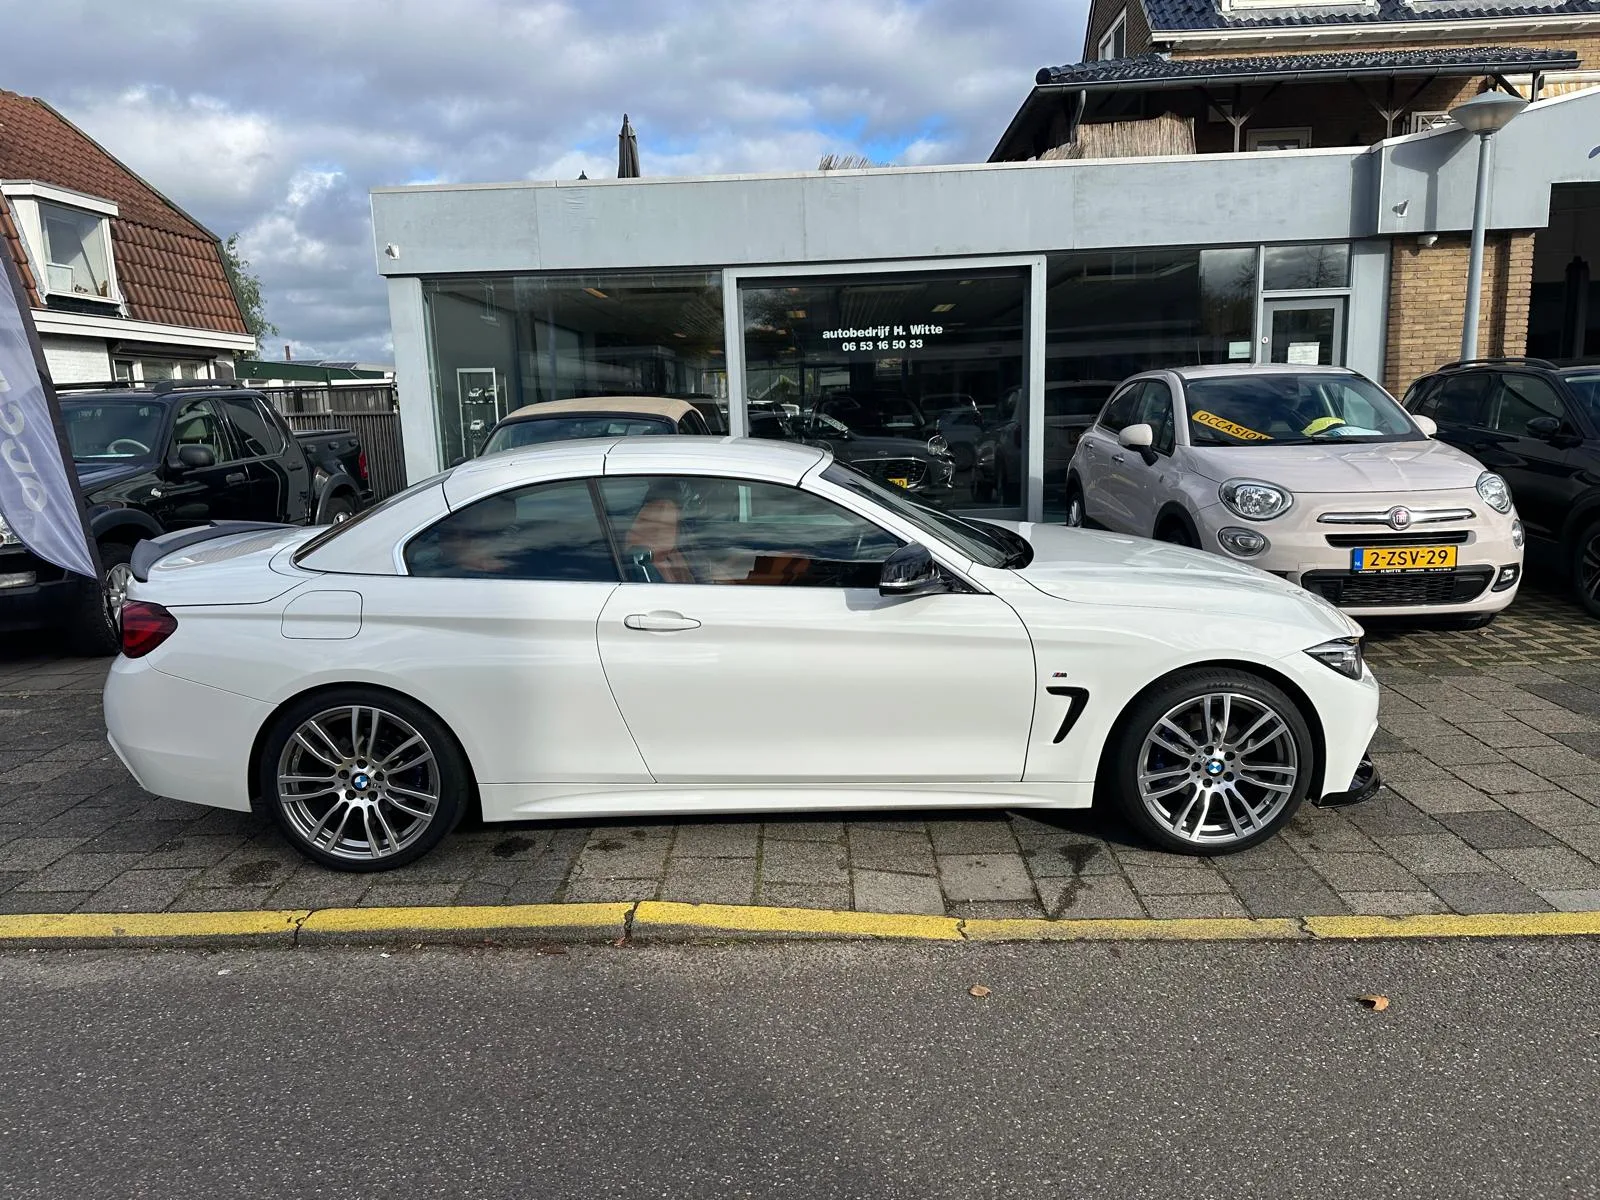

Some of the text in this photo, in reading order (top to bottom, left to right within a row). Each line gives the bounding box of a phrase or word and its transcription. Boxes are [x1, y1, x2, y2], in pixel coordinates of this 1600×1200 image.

[822, 324, 943, 339] autobedrijf H. Witte
[842, 339, 923, 351] 06 53 16 50 33
[1370, 550, 1448, 567] 2-ZSV-29
